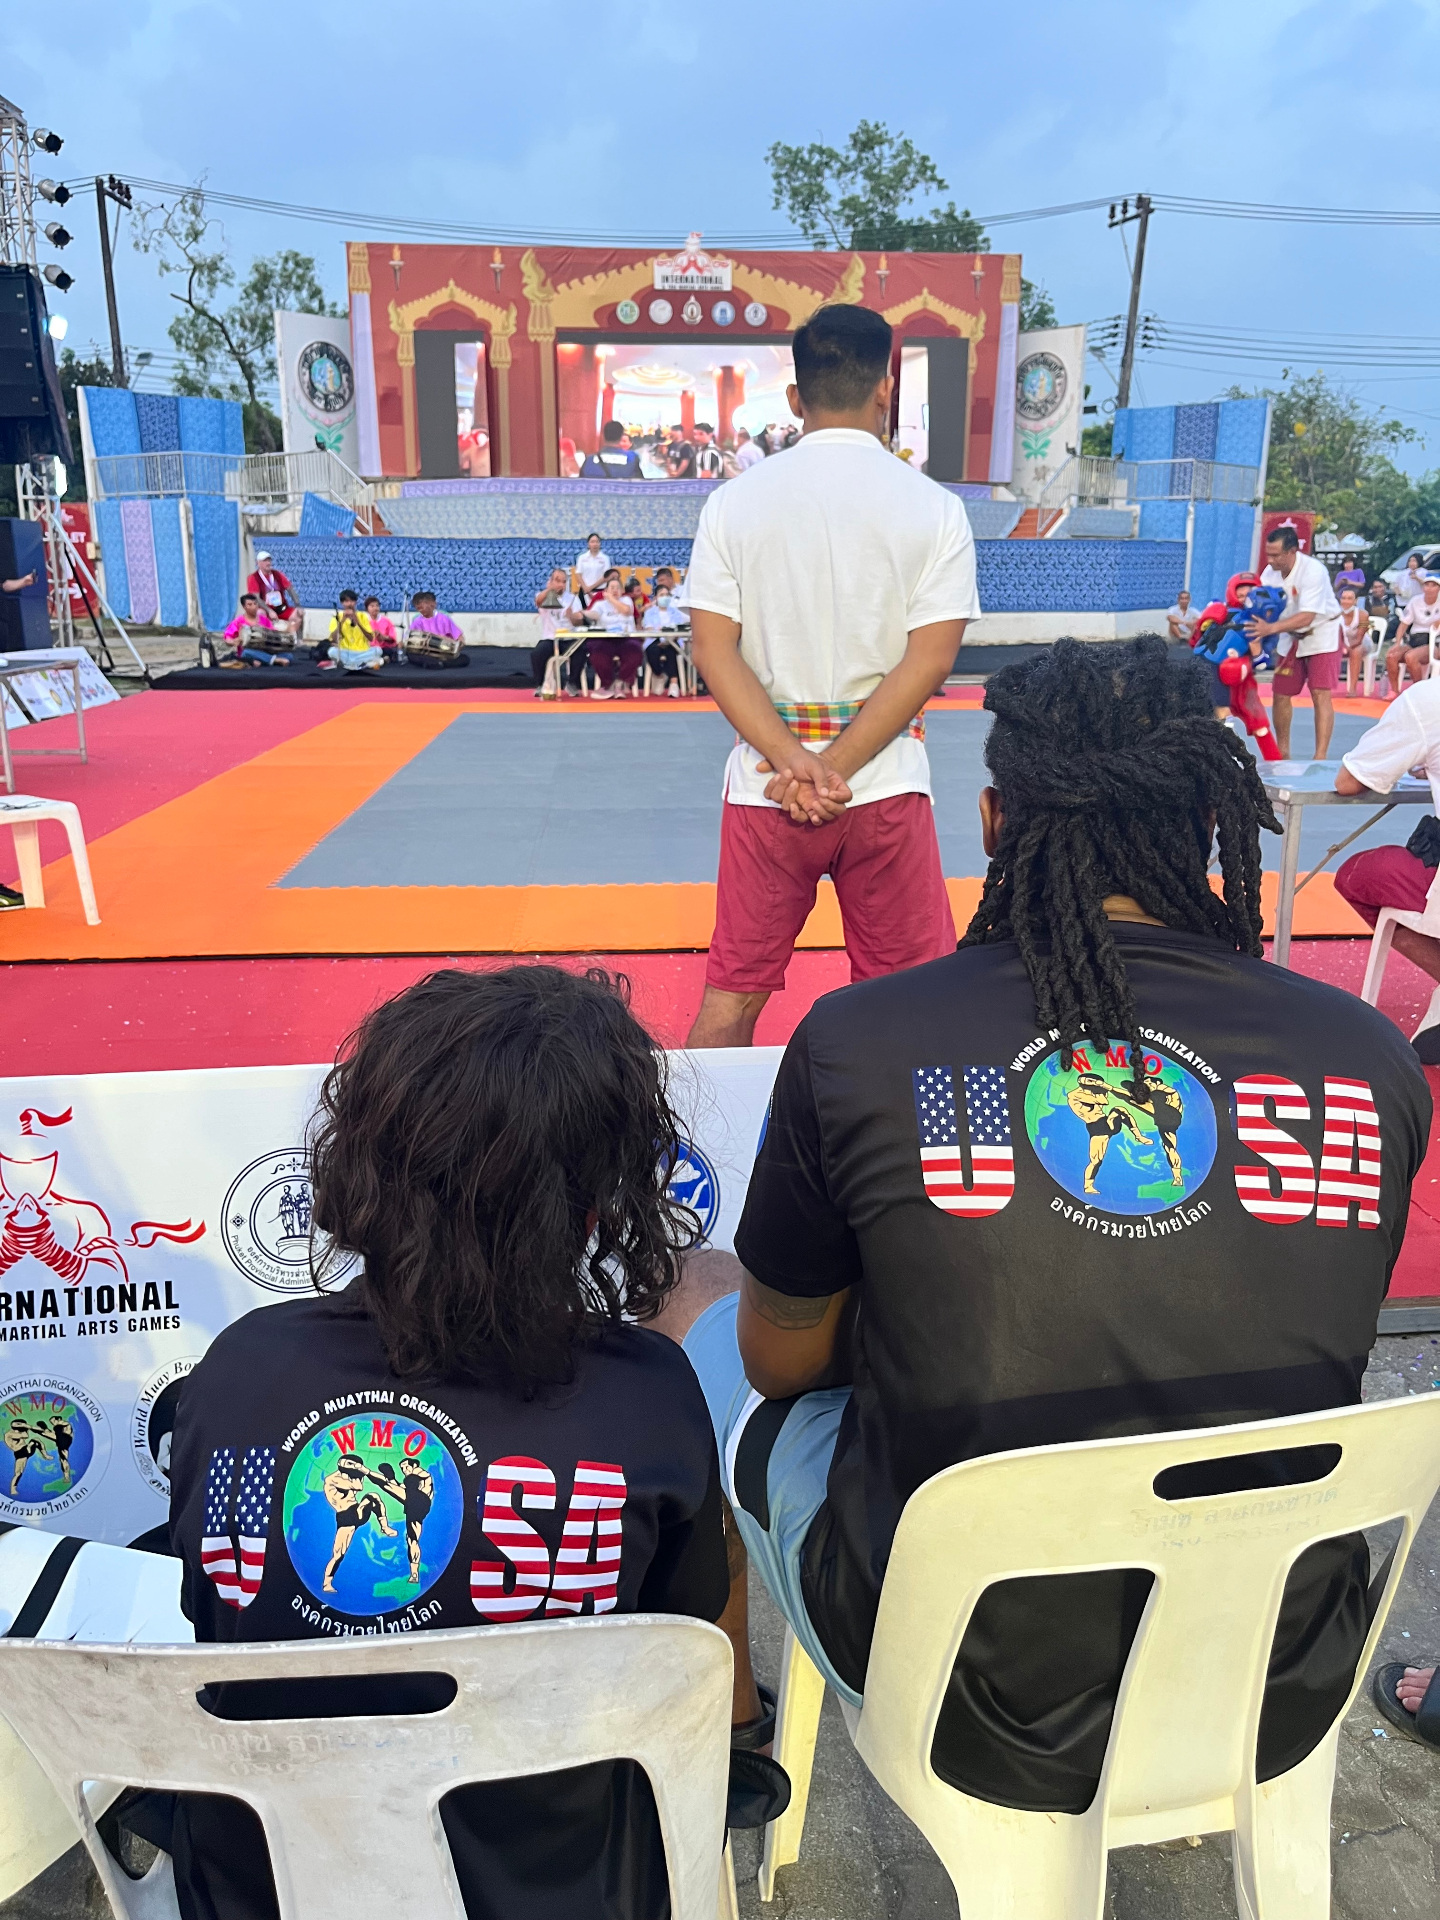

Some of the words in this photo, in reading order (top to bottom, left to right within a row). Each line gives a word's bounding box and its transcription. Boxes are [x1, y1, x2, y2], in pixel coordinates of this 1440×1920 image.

[1009, 1037, 1047, 1073] WORLD
[1050, 1195, 1212, 1239] องค์กรมวยไทยโลก
[231, 1234, 246, 1260] Phuket
[244, 1258, 279, 1283] Provincial
[77, 1320, 118, 1336] ARTS
[128, 1315, 181, 1332] GAMES
[43, 1378, 104, 1423] ORGANIZATION
[134, 1408, 148, 1448] World
[141, 1371, 170, 1407] Muay
[281, 1410, 321, 1453] WORLD
[324, 1390, 395, 1415] MUAYTHAI
[399, 1394, 479, 1467] ORGANIZATION
